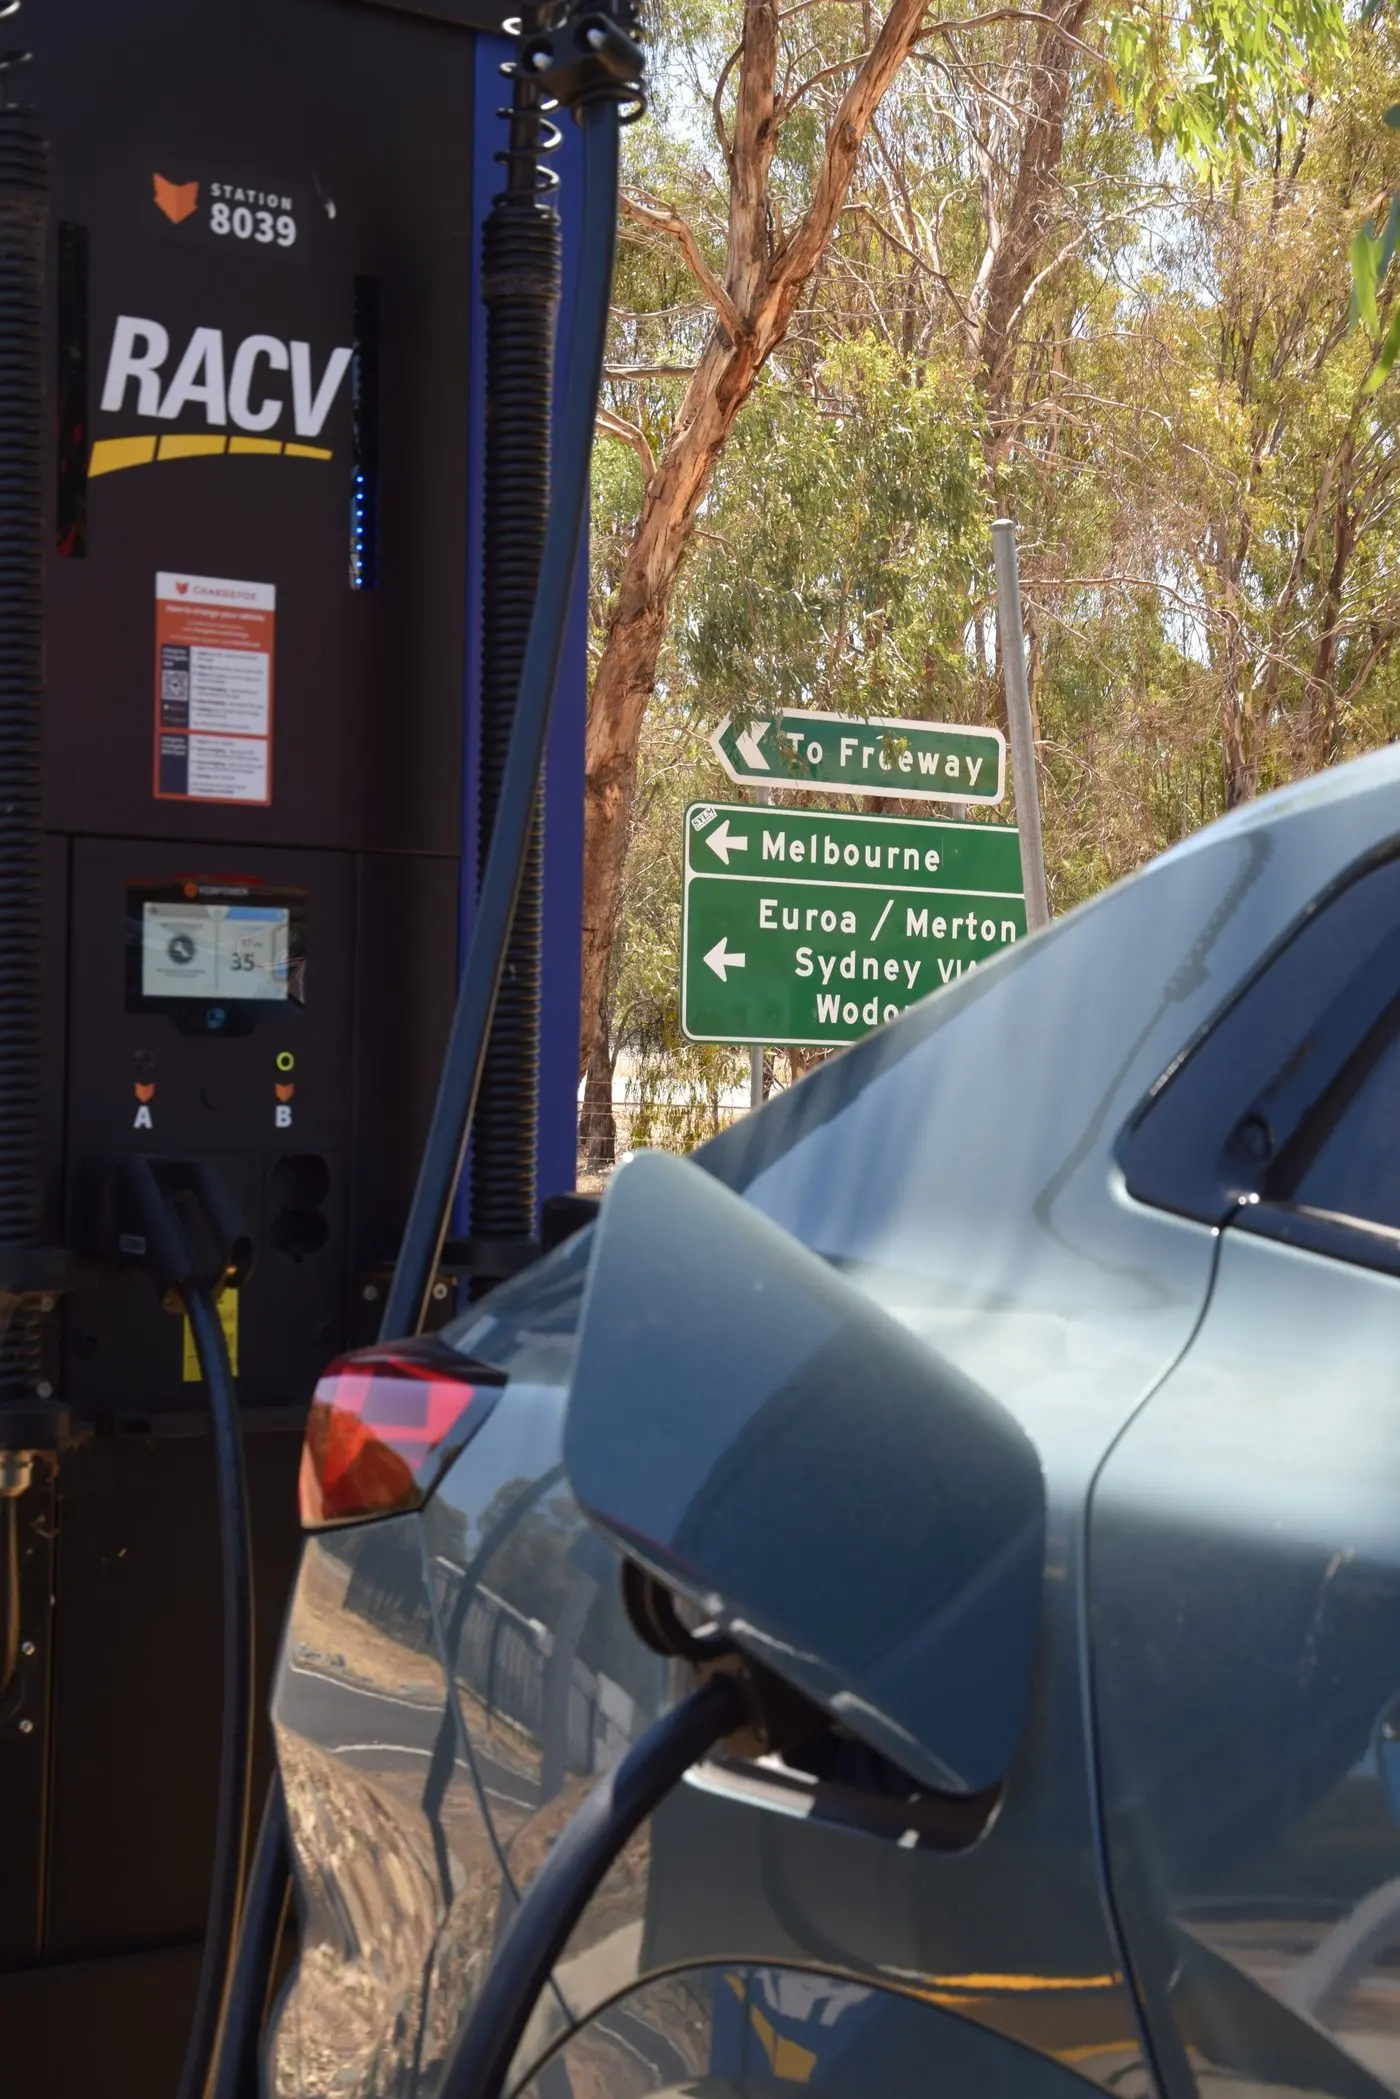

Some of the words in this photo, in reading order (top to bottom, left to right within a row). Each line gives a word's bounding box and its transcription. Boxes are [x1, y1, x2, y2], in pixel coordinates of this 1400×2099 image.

[209, 182, 293, 211] STATION
[210, 202, 297, 247] 8039
[100, 315, 354, 438] RACV
[786, 732, 823, 765] To
[762, 830, 940, 872] Melbourne
[759, 898, 857, 934] Euroa
[870, 899, 894, 942] /
[906, 907, 1016, 943] Merton
[231, 951, 255, 972] 35
[795, 947, 921, 989] Sydney
[816, 993, 909, 1026] Wodo
[133, 1105, 153, 1128] A
[275, 1105, 292, 1127] B
